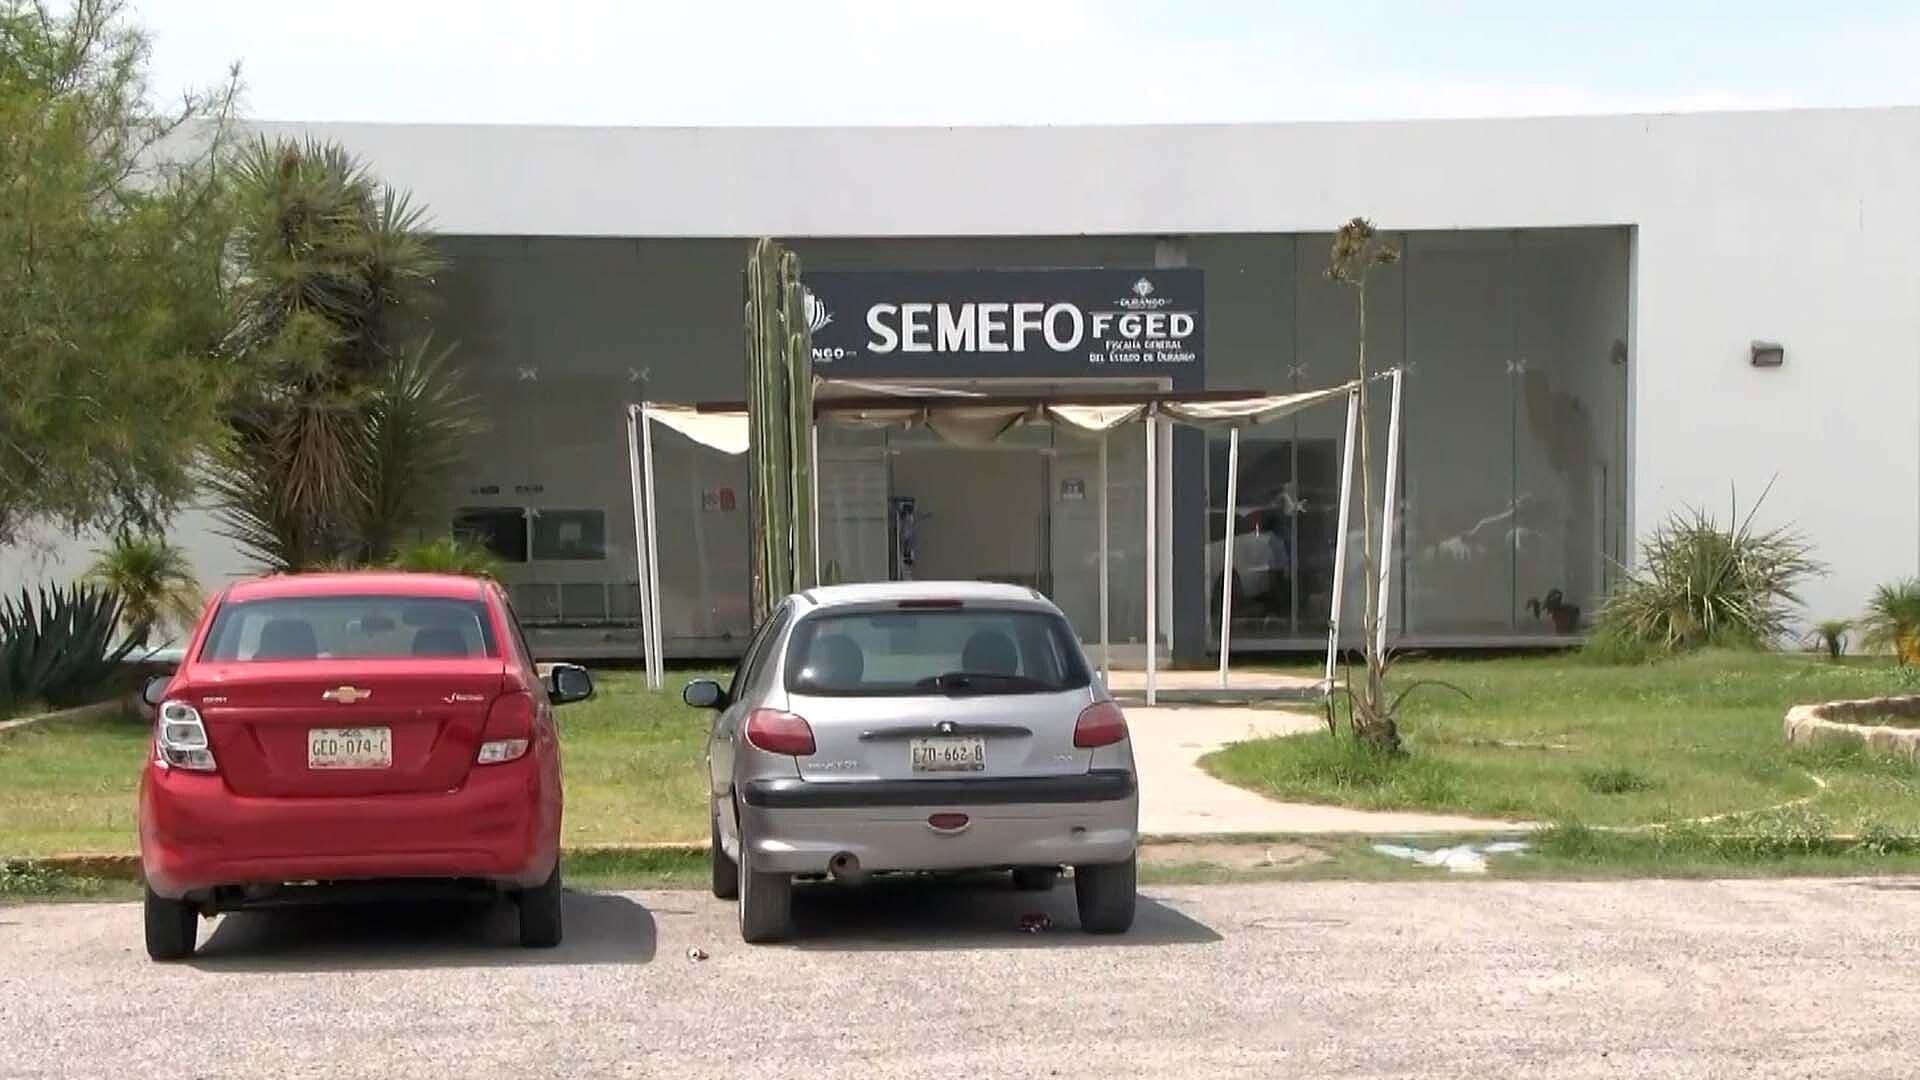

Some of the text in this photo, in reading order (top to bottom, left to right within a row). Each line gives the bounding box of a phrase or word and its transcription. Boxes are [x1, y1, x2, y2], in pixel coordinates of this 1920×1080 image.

[866, 302, 1084, 352] SEMEFO
[1144, 340, 1182, 349] GENERAL
[1089, 353, 1105, 362] DEL
[1109, 352, 1140, 362] ESTADO
[1157, 351, 1196, 362] DURANGO
